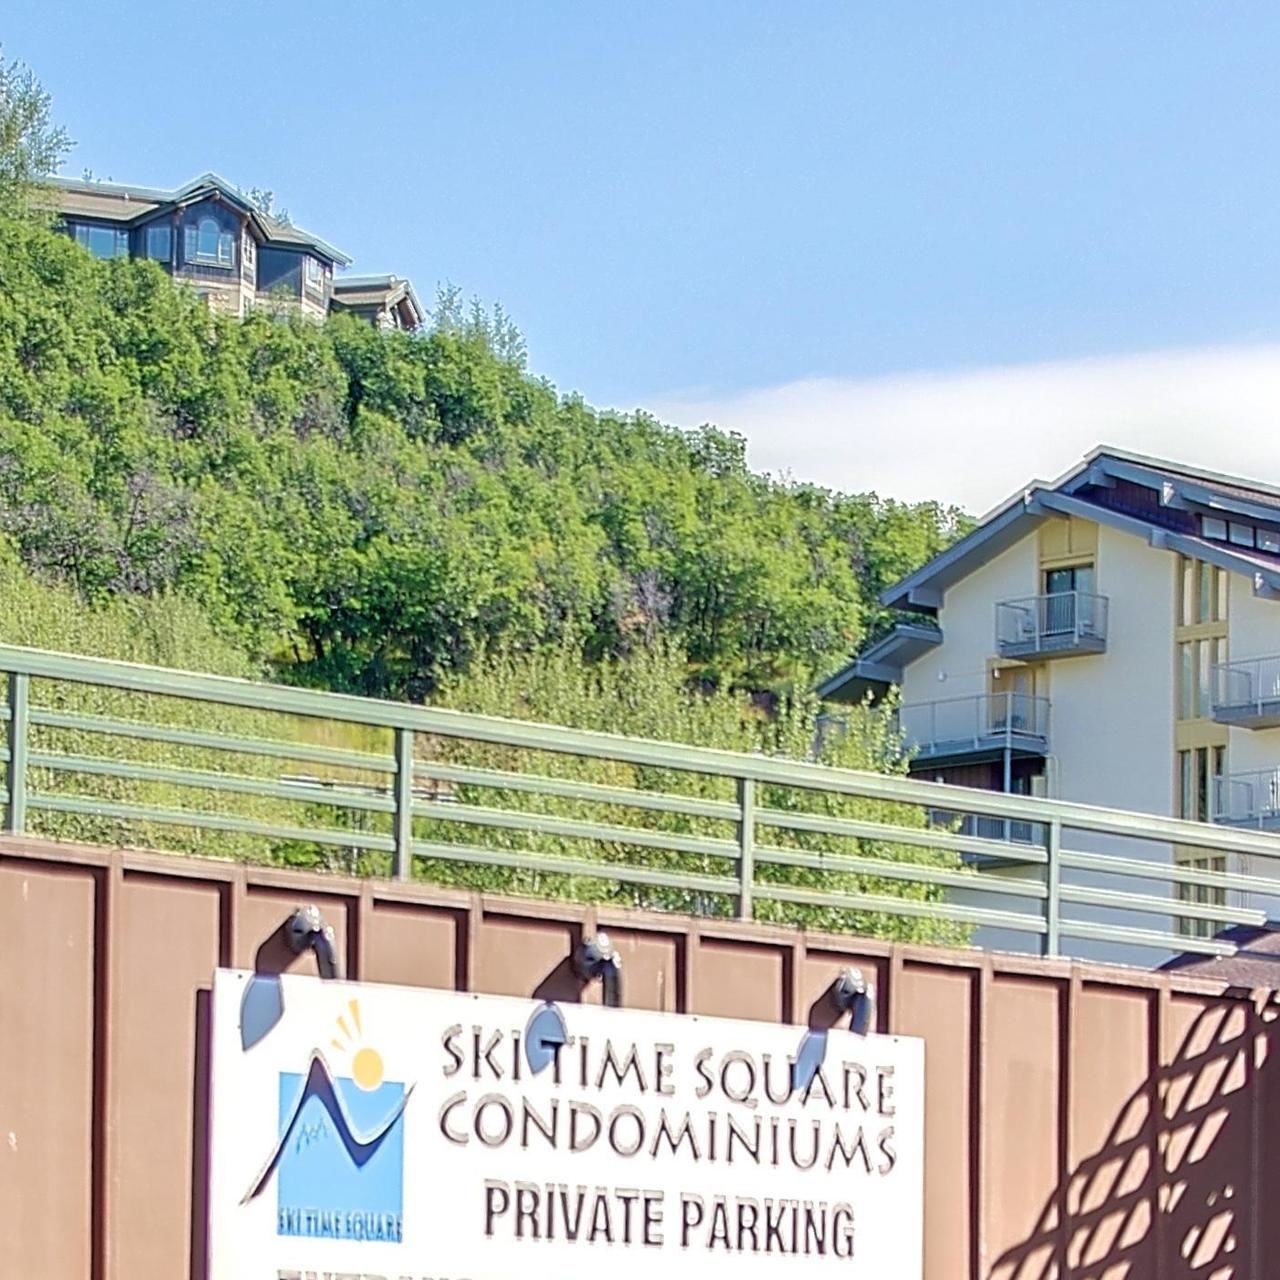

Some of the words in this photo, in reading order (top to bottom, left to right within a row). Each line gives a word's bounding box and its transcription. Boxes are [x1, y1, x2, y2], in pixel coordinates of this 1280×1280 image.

[439, 1023, 521, 1083] SKI
[538, 1035, 676, 1098] TIME
[694, 1046, 897, 1118] SQUARE
[438, 1090, 897, 1176] CONDOMINIUMS
[277, 1208, 301, 1234] SKI
[305, 1208, 341, 1239] TIME
[345, 1212, 402, 1243] SQUARE
[483, 1178, 665, 1248] PRIVATE
[679, 1192, 856, 1258] PARKING
